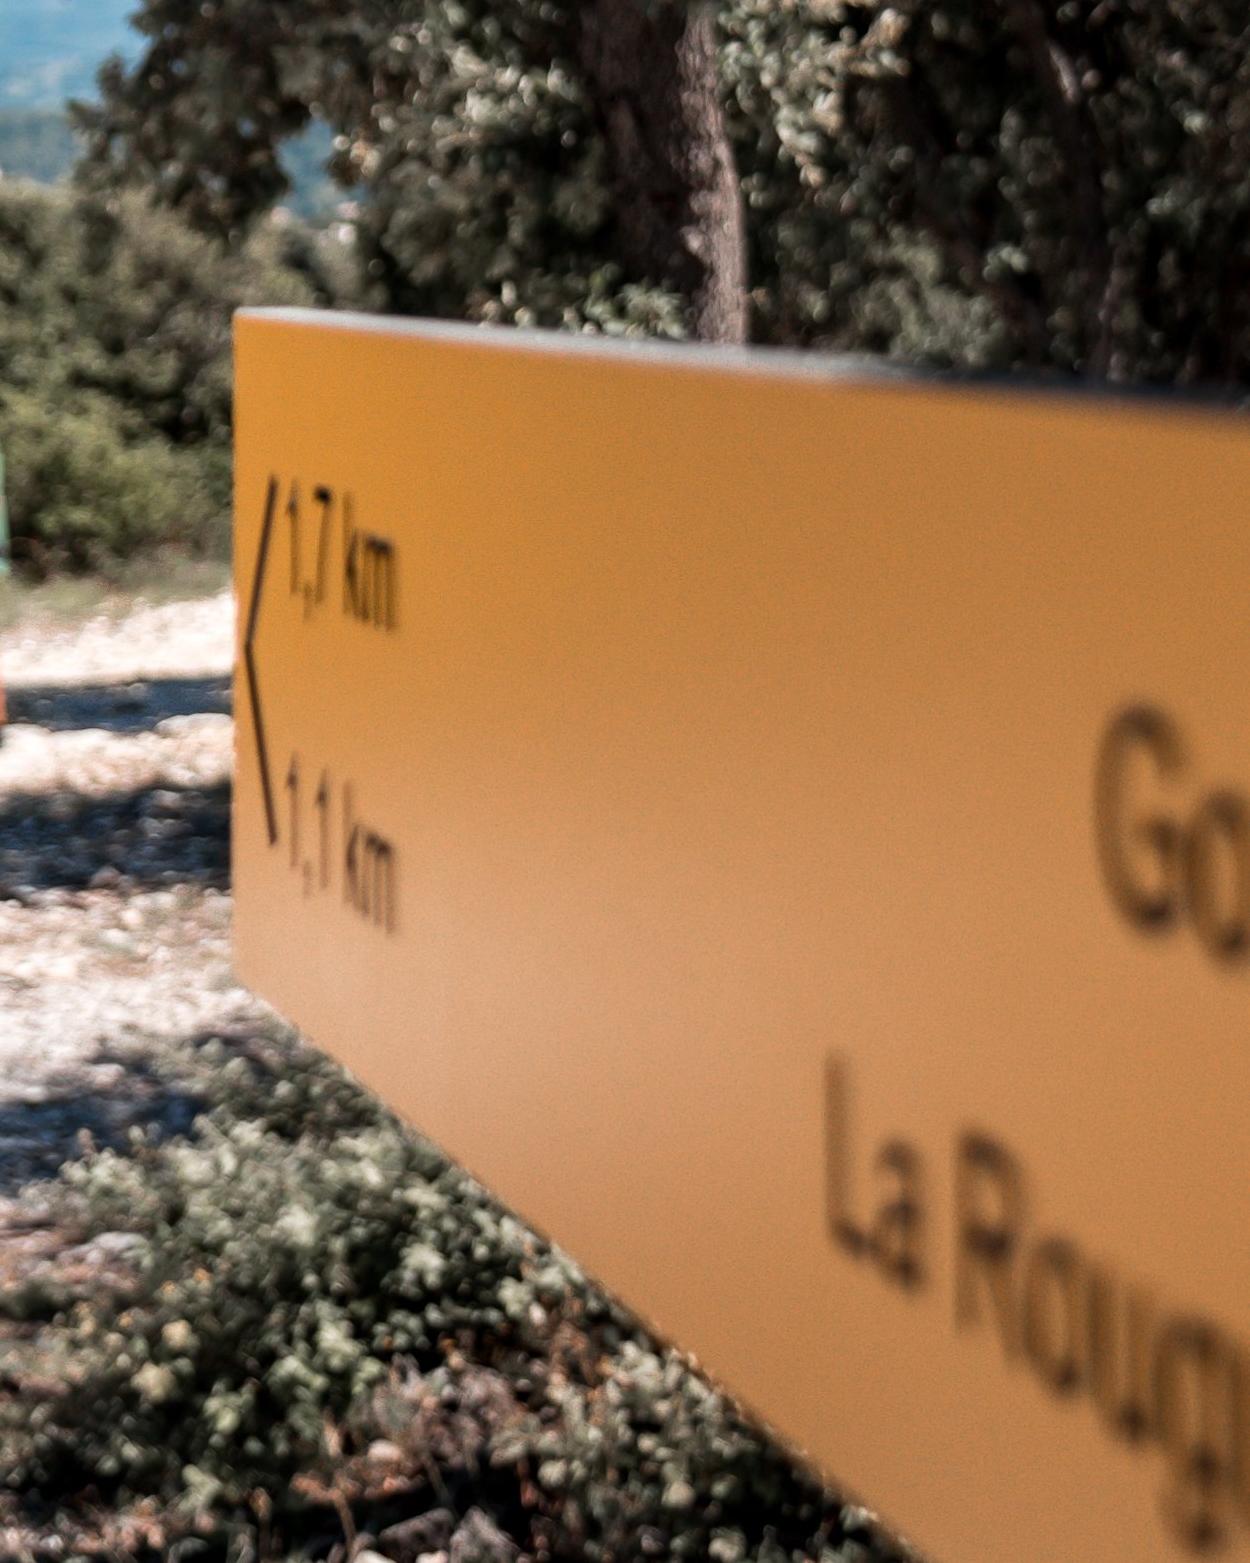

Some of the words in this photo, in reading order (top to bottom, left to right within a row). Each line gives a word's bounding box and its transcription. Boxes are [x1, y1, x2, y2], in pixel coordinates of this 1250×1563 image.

[286, 478, 333, 622] 1,7
[343, 488, 398, 634] km
[285, 752, 329, 901] 1,1
[343, 780, 398, 935] km
[824, 1048, 924, 1296] La
